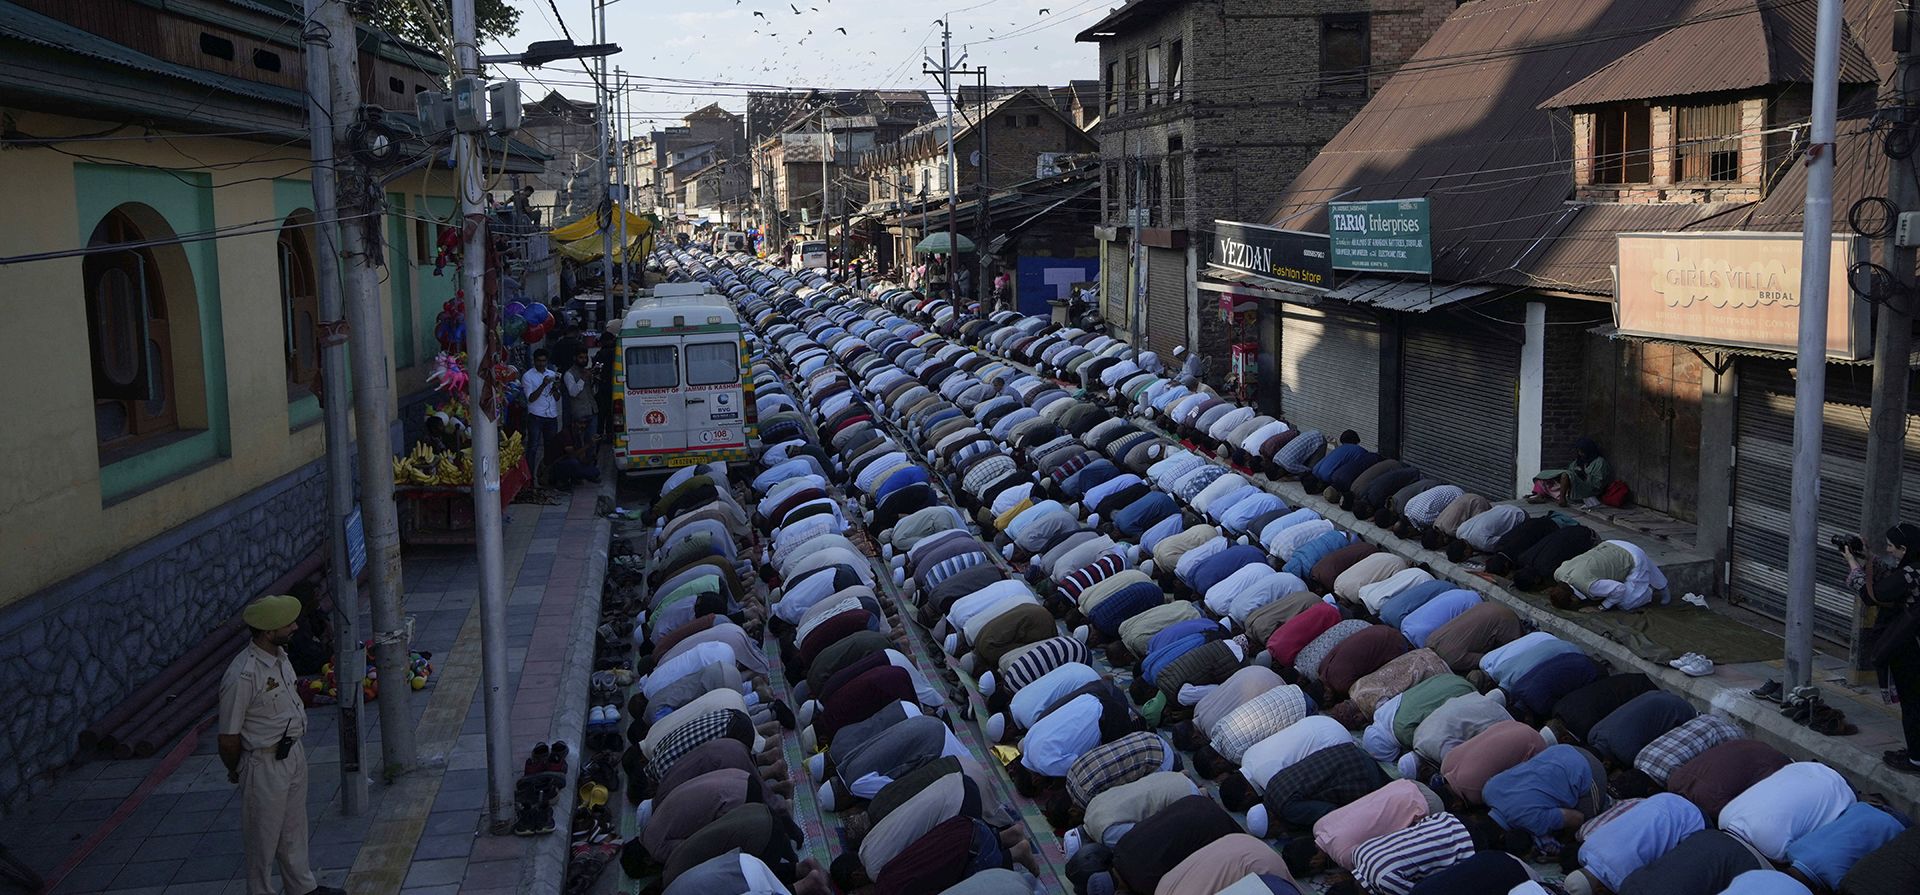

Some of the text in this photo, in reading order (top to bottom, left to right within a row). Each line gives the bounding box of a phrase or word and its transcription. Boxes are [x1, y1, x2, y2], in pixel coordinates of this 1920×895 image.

[1369, 213, 1420, 235] Enterprises
[1221, 238, 1272, 272] YEZDAN
[1273, 264, 1322, 284] Fashion Store
[1665, 268, 1782, 292] GIRLS VILLA
[1759, 291, 1794, 301] BRIDAL
[627, 388, 670, 396] GOVERNMENT
[713, 430, 727, 438] 108
